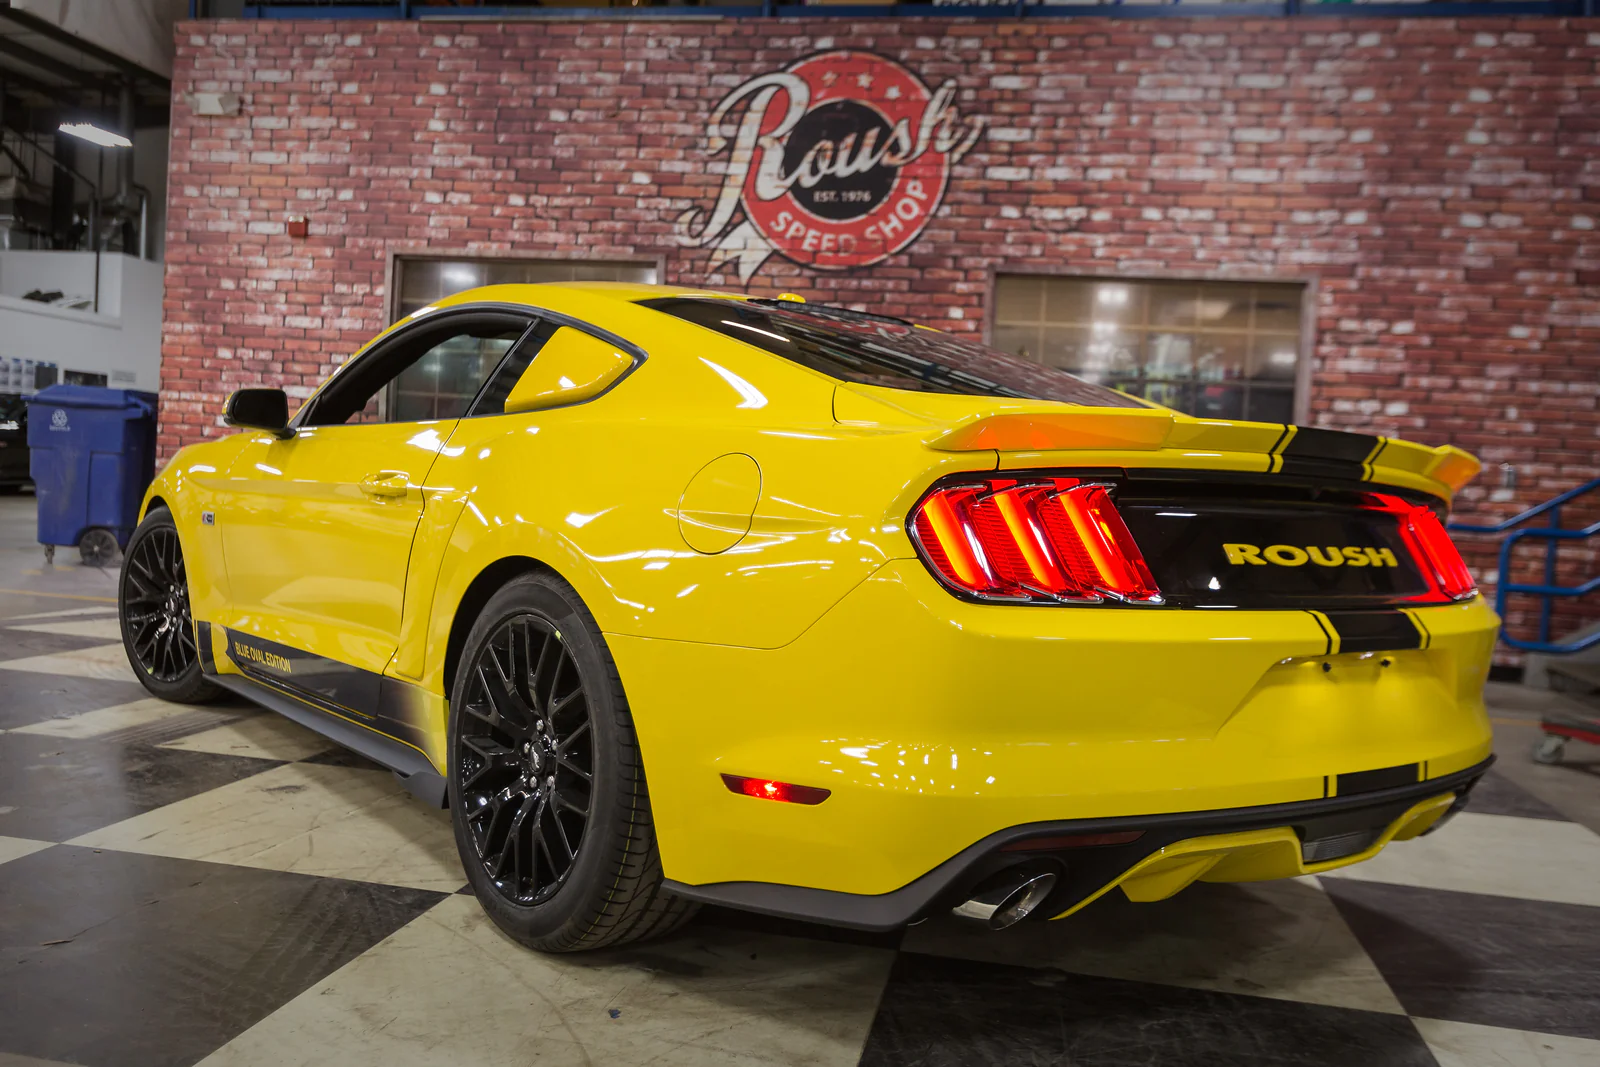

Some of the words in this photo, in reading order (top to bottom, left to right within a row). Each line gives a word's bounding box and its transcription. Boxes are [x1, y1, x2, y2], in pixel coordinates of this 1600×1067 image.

[677, 72, 985, 247] Roush
[813, 189, 839, 202] EST.
[841, 189, 872, 202] 1976
[769, 211, 857, 256] SPEED
[865, 180, 928, 248] SHOP
[1222, 543, 1398, 567] ROUSH
[234, 641, 251, 659] BLUE
[250, 646, 267, 665] OVAL
[265, 651, 292, 673] EDITION
